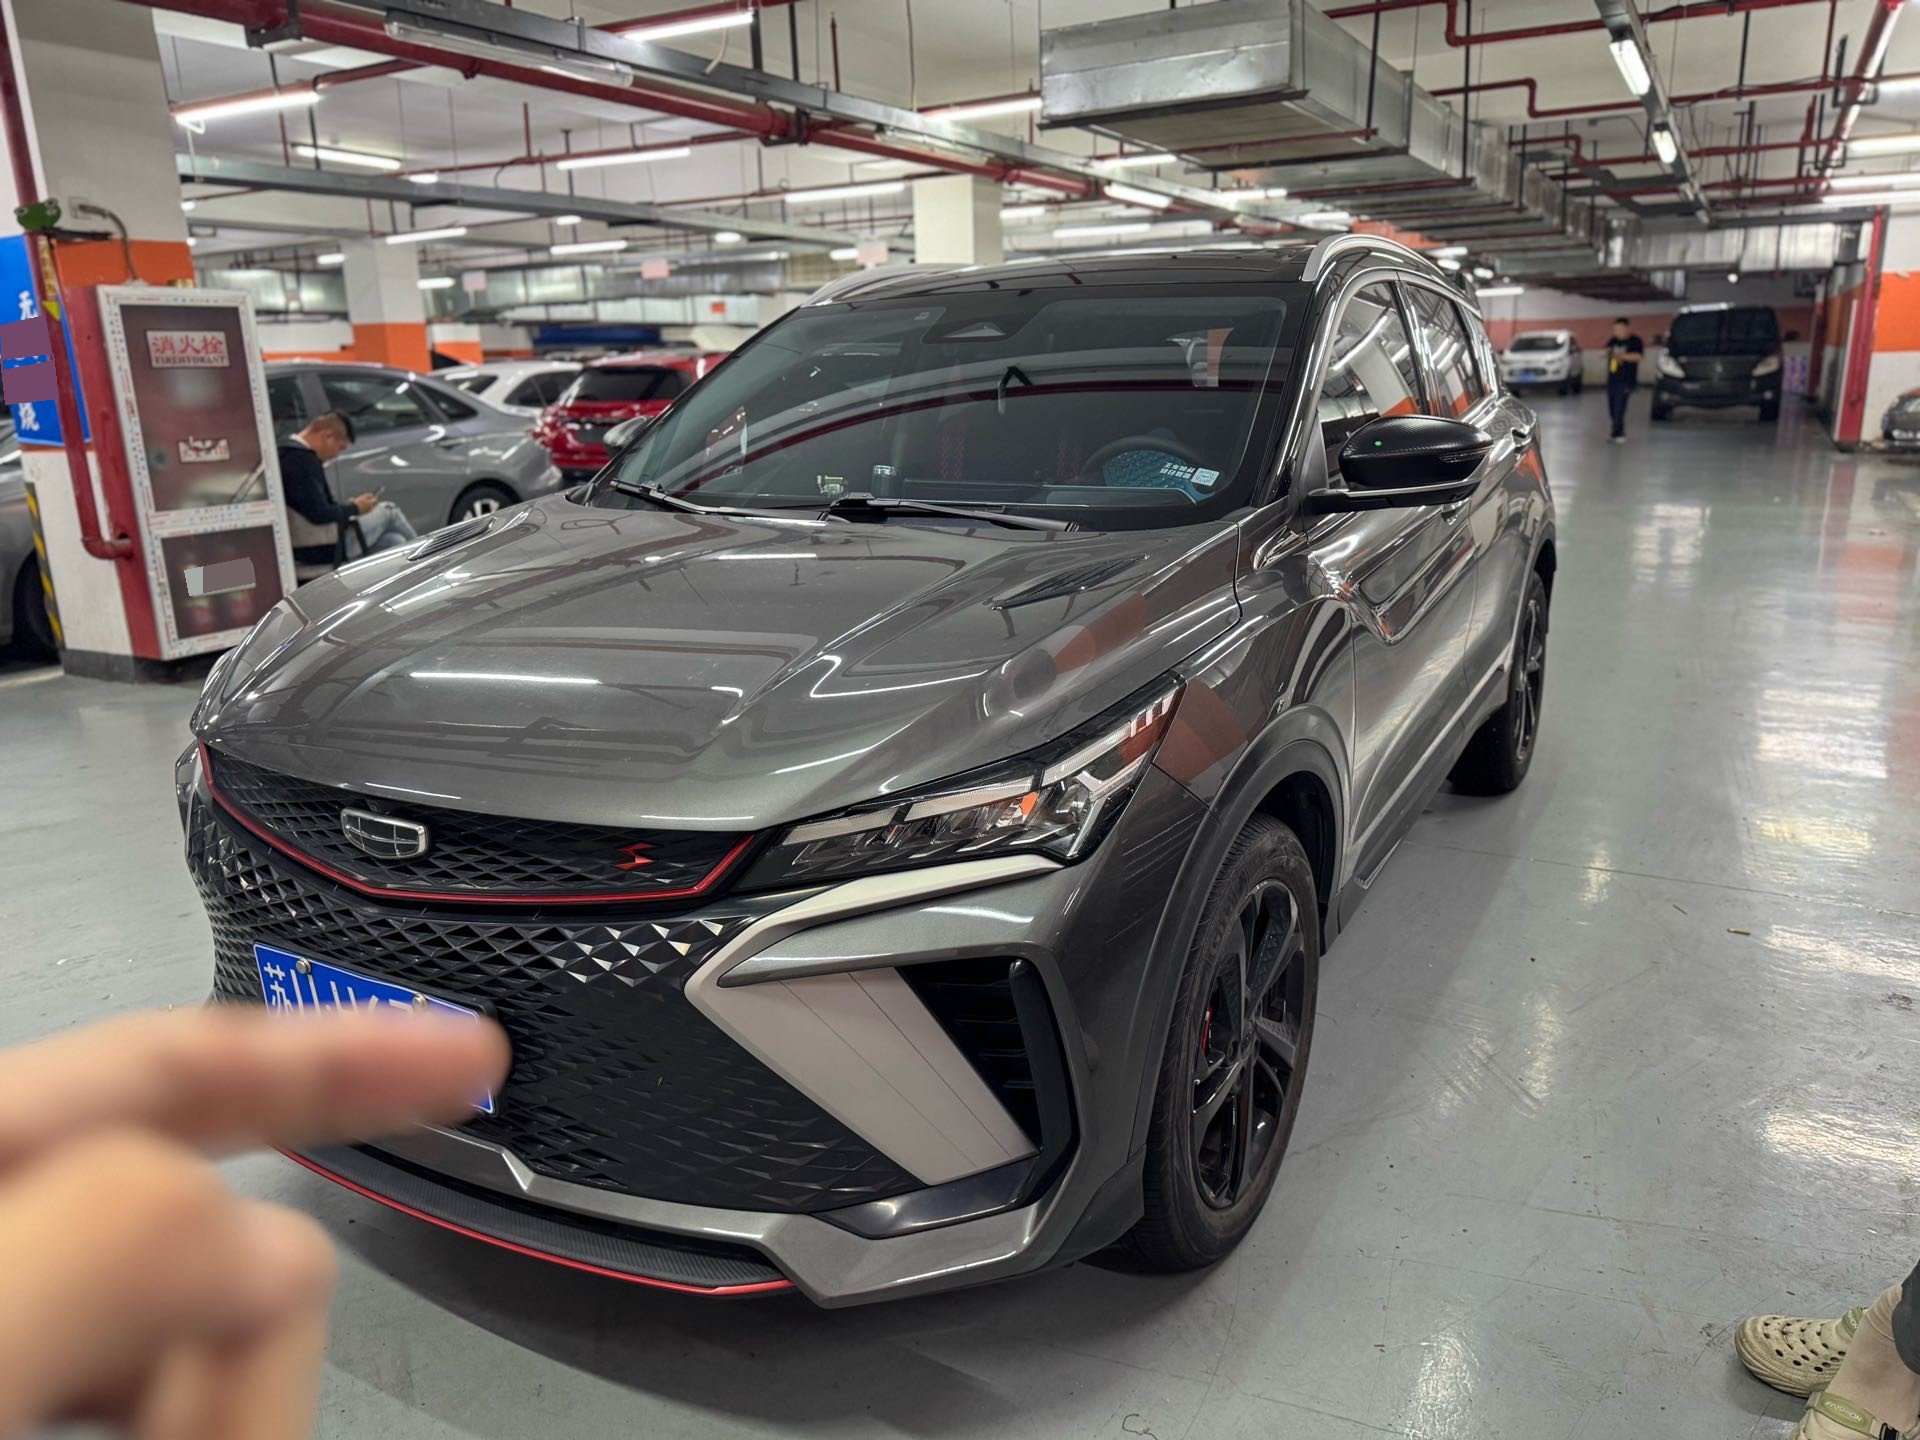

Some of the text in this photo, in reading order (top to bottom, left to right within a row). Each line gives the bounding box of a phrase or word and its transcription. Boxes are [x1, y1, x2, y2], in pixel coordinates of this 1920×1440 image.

[152, 334, 224, 355] 消火栓
[1825, 1400, 1863, 1422] FASHION
